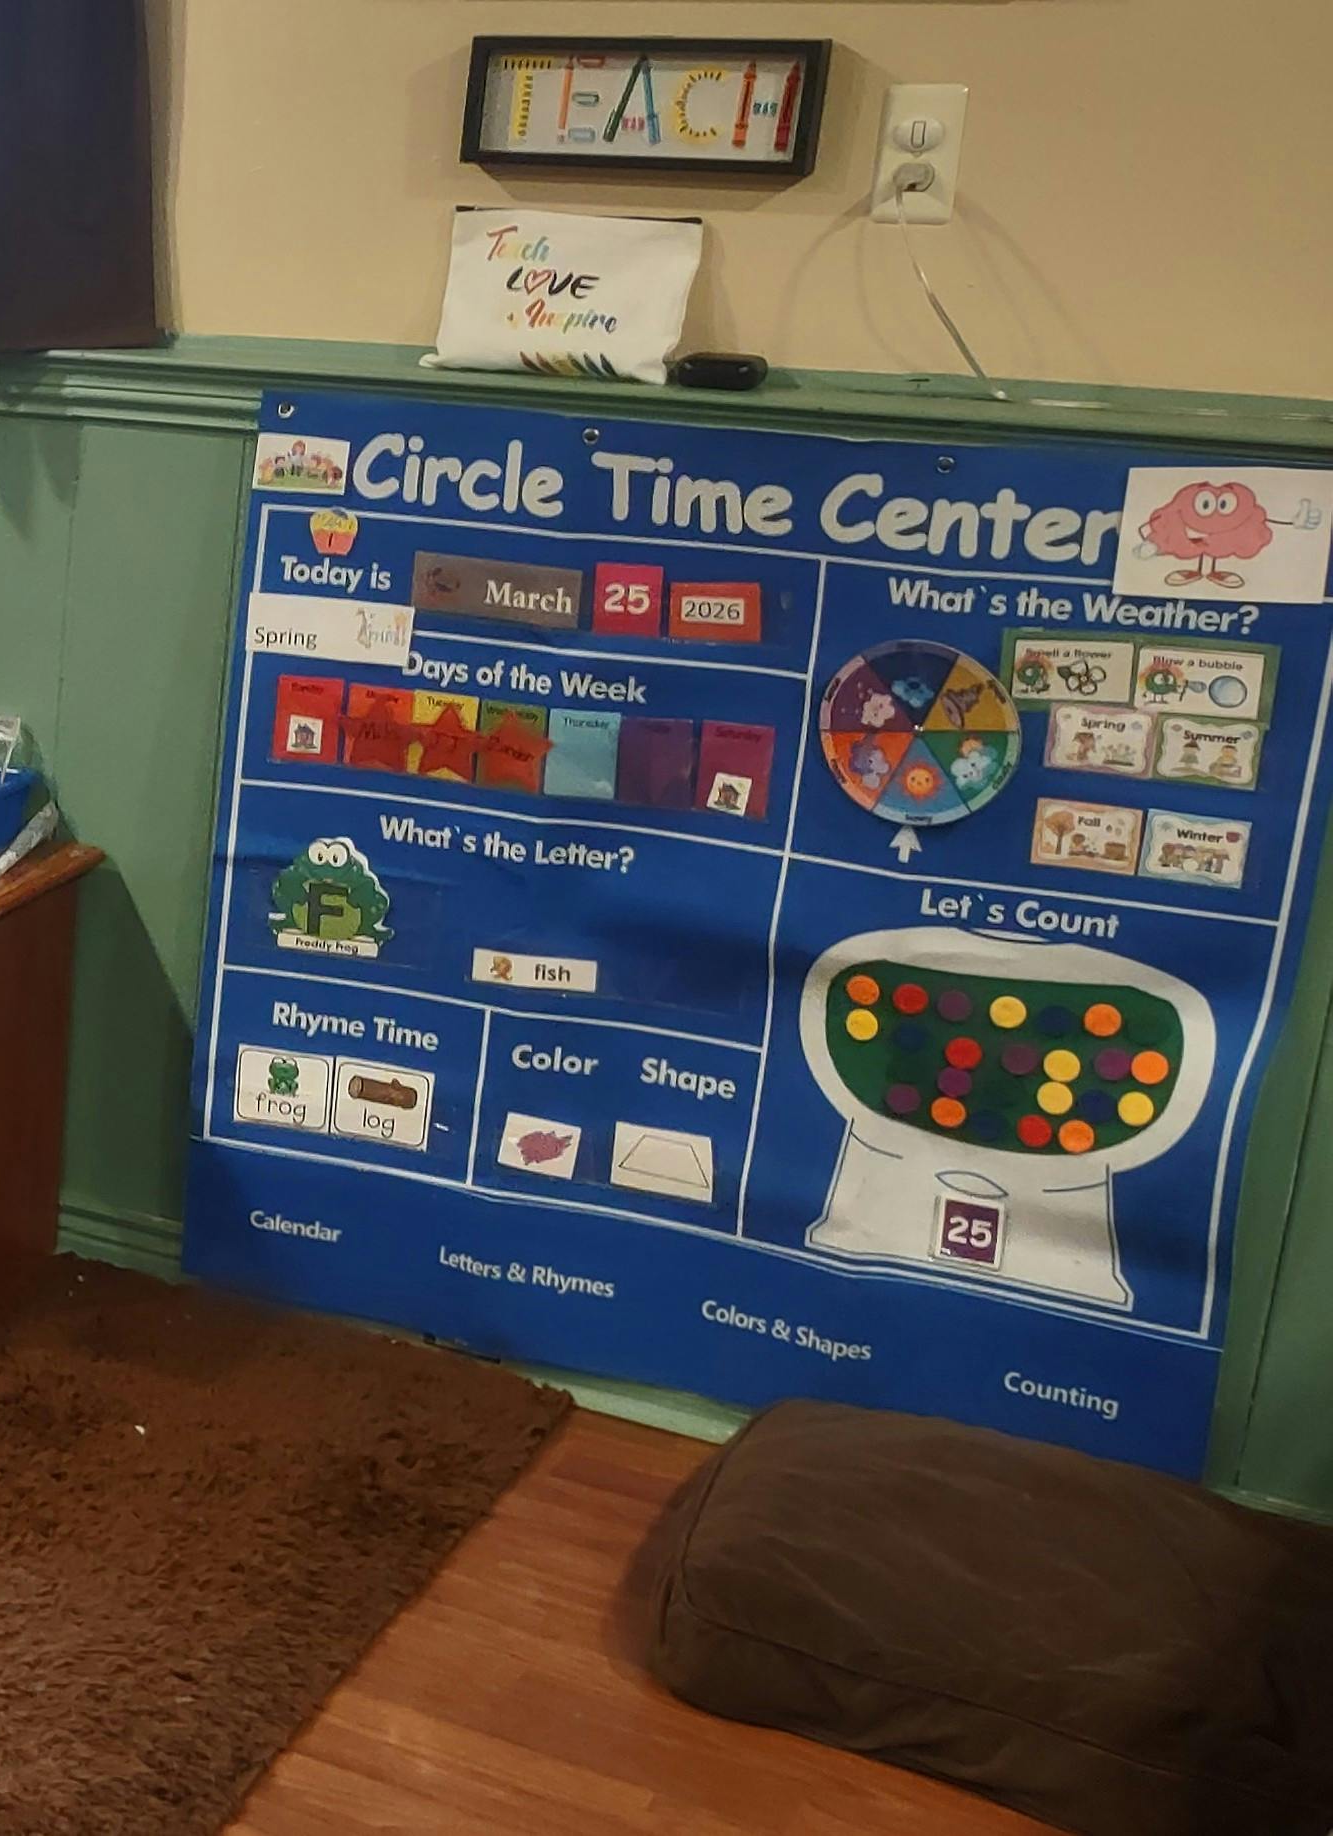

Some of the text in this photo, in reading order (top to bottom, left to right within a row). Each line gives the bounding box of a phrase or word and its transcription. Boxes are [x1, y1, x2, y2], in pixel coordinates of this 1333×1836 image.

[500, 54, 800, 152] TEACH
[352, 433, 1120, 566] Circle Time Center
[281, 555, 391, 593] Today is
[484, 579, 572, 616] March
[603, 583, 651, 614] 25
[682, 600, 742, 622] 2026
[1016, 590, 1071, 622] the
[1082, 592, 1261, 635] Weather?
[254, 625, 318, 650] Spring
[401, 652, 649, 704] Days of the Week
[1198, 659, 1245, 672] bubble
[1080, 716, 1127, 733] Spring
[1183, 729, 1243, 745] Summer
[1076, 815, 1101, 829] Fall
[1176, 828, 1225, 845] Winter
[482, 831, 527, 864] the
[534, 839, 634, 875] Letter?
[306, 883, 350, 937] F
[1015, 899, 1121, 940] Count
[533, 962, 572, 984] fish
[272, 1001, 440, 1052] Rhyme Time
[511, 1044, 600, 1077] Color
[639, 1056, 737, 1100] Shape
[255, 1092, 308, 1124] frog
[361, 1107, 396, 1138] log
[249, 1209, 343, 1243] Calendar
[947, 1216, 993, 1249] 25
[439, 1245, 615, 1298] Letters & Rhymes
[701, 1299, 872, 1361] Colors & Shapes
[1004, 1371, 1120, 1420] Counting
